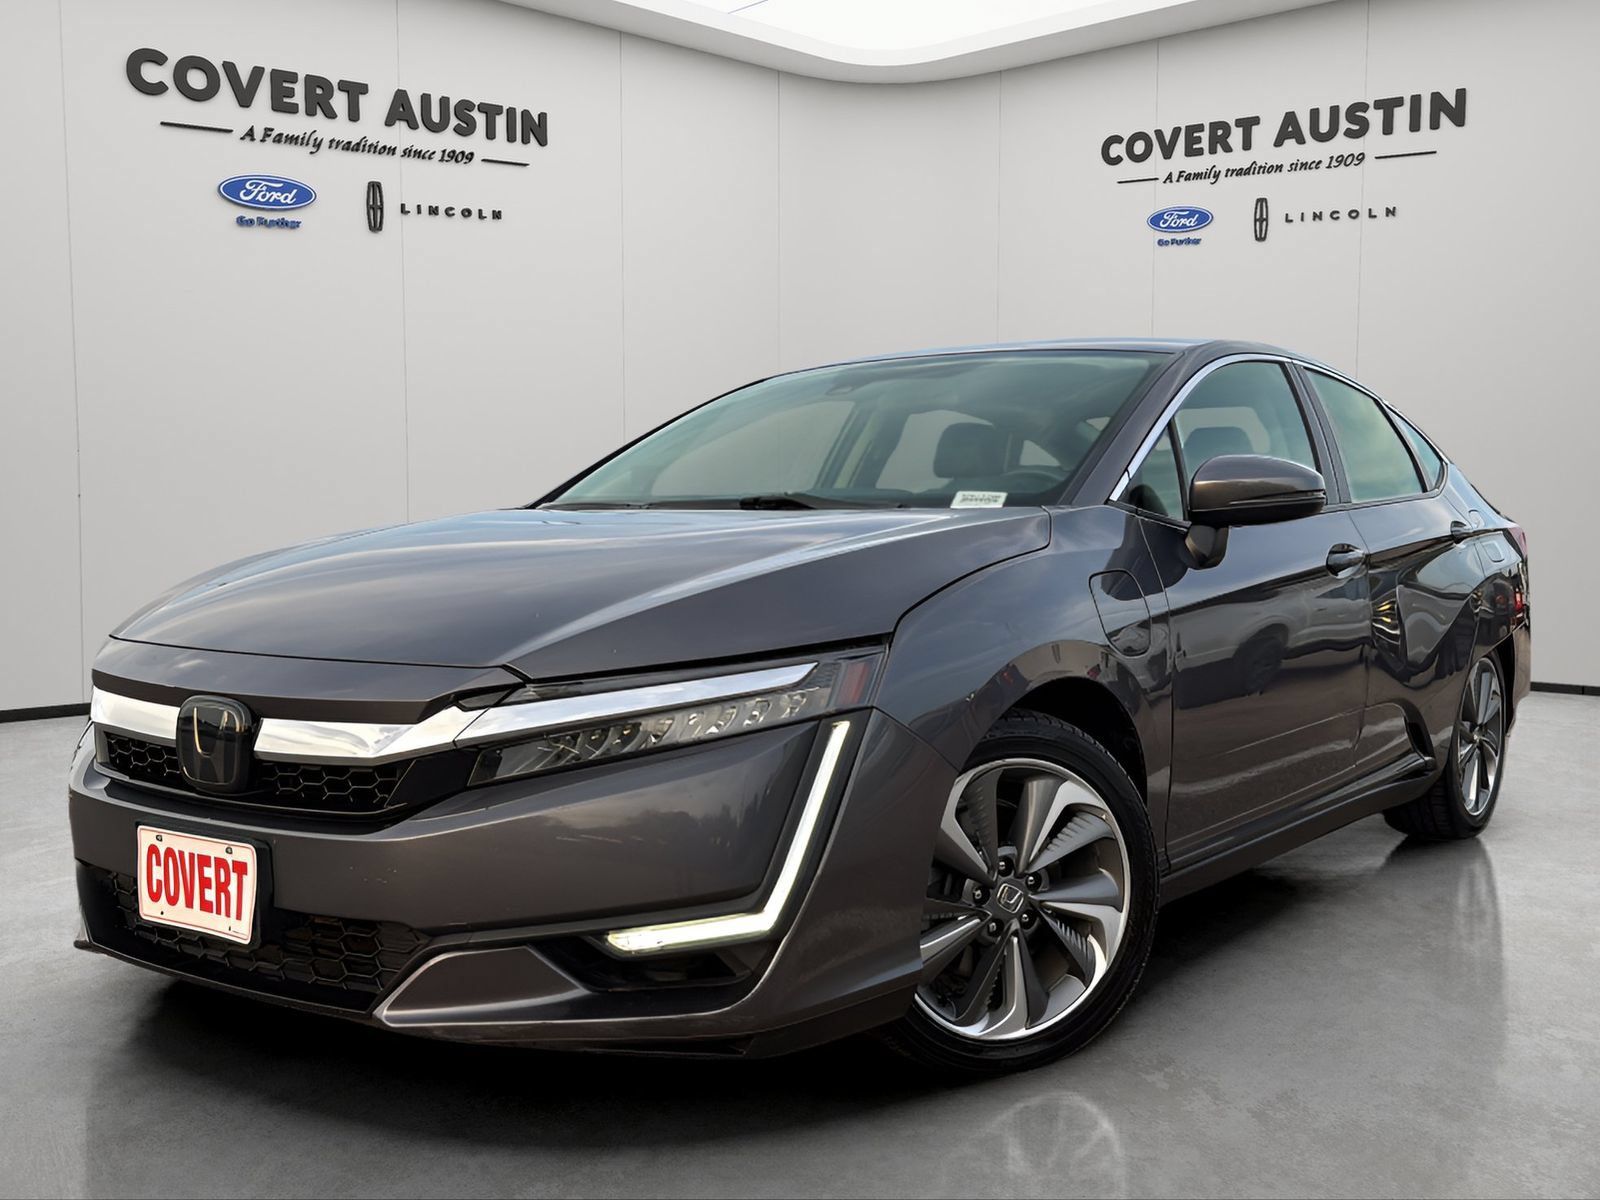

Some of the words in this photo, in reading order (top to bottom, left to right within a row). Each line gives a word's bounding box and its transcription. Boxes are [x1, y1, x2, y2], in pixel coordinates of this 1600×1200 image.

[126, 47, 369, 122] COVERT
[384, 88, 548, 147] AUSTIN
[1101, 115, 1260, 166] COVERT
[1273, 87, 1467, 148] AUSTIN
[240, 125, 256, 142] A
[260, 127, 324, 155] Family
[328, 136, 397, 156] tradition
[401, 145, 436, 161] since
[438, 149, 475, 165] 1909
[1163, 172, 1173, 184] A
[1176, 165, 1221, 185] Family
[1225, 160, 1284, 178] tradition
[1288, 158, 1322, 173] since
[1325, 152, 1366, 169] 1909
[239, 179, 298, 204] Ford
[400, 203, 502, 220] LINCOLN
[1160, 211, 1199, 228] Ford
[1285, 206, 1396, 223] LINCOLN
[146, 843, 248, 921] COVERT
